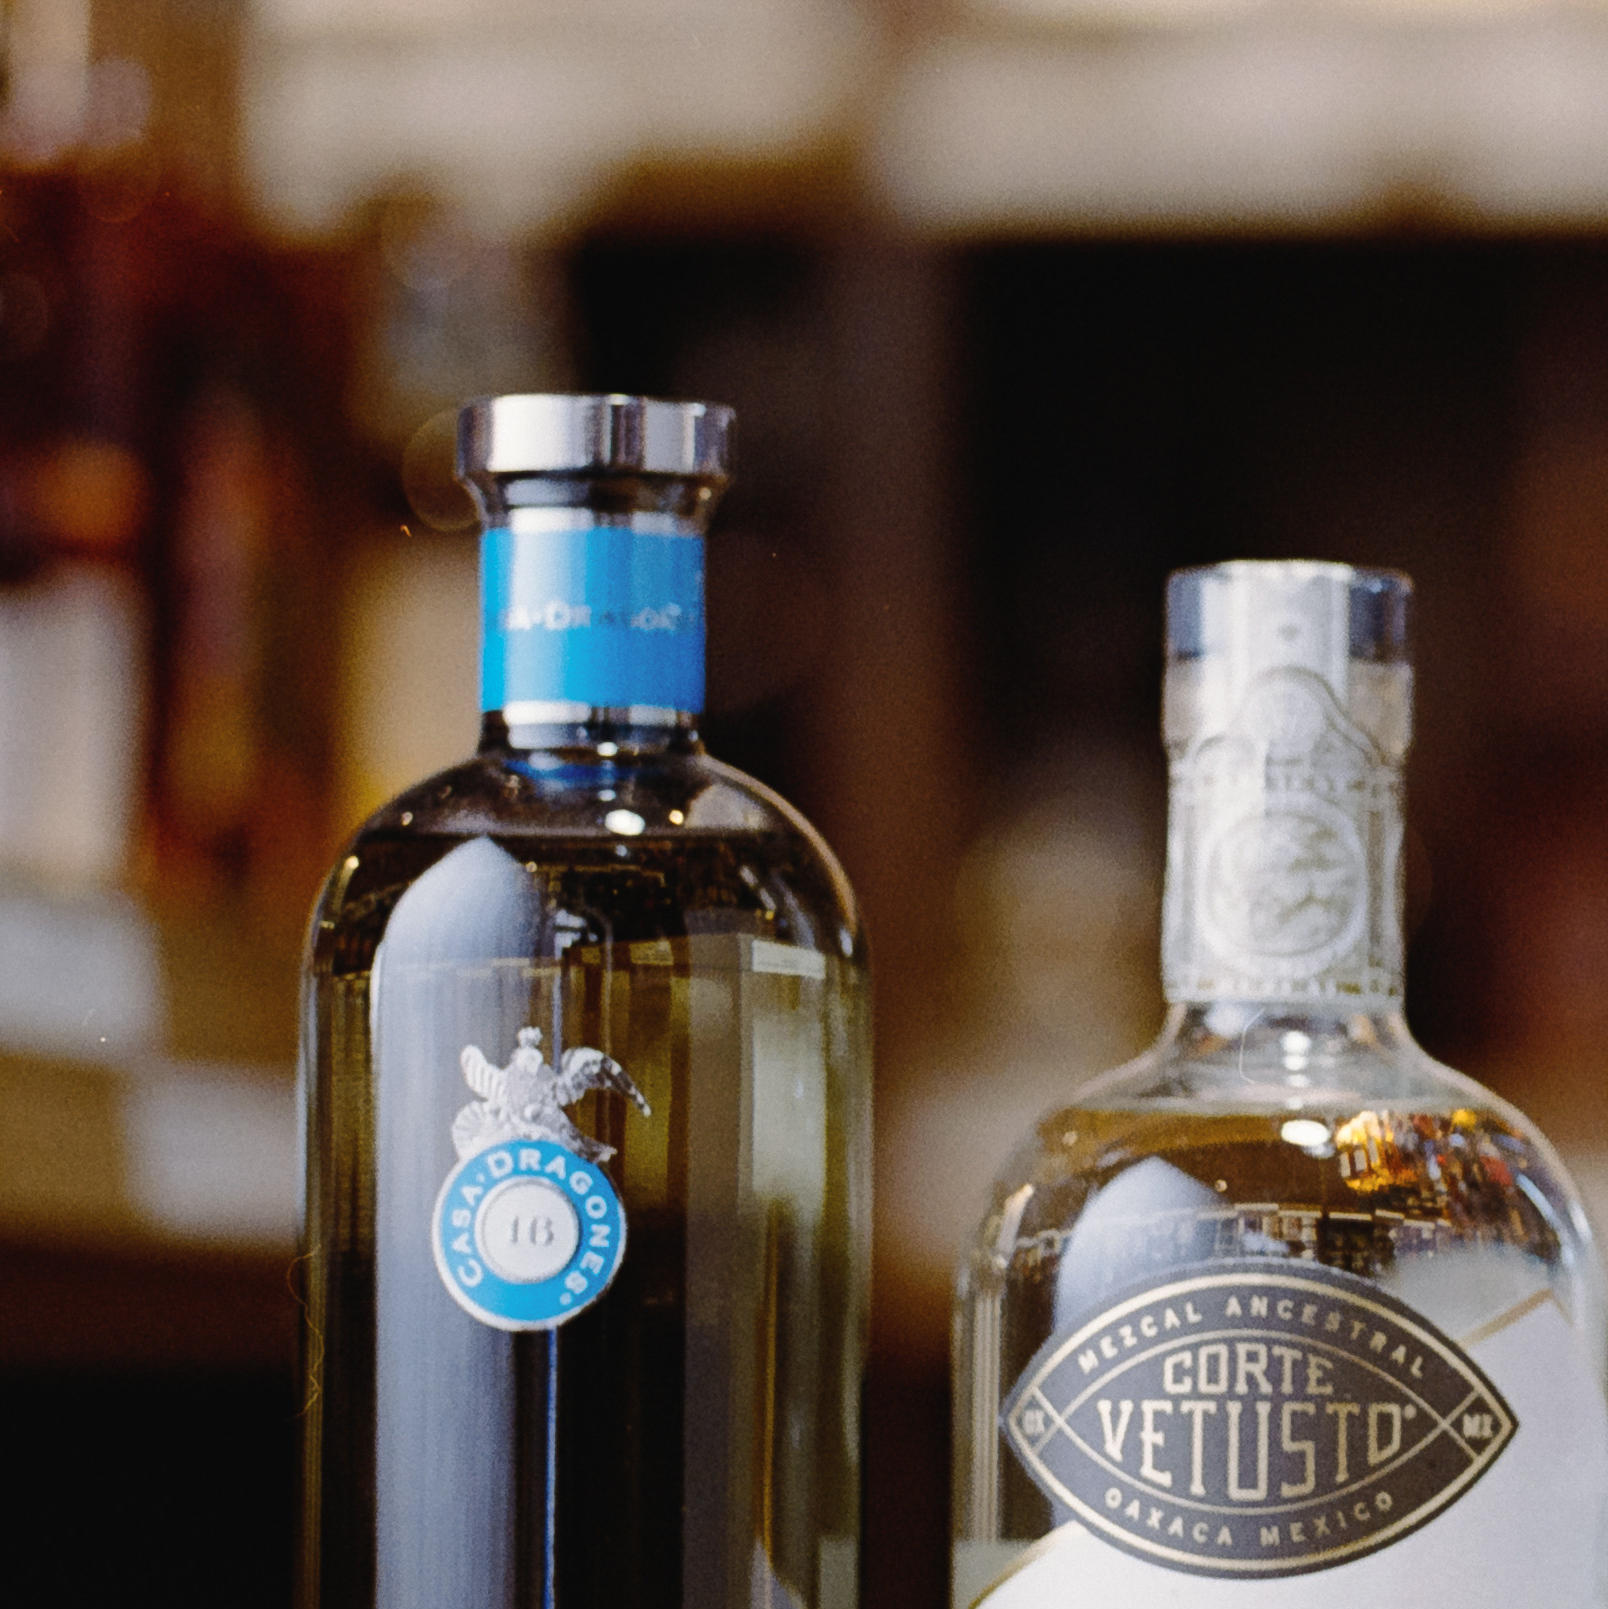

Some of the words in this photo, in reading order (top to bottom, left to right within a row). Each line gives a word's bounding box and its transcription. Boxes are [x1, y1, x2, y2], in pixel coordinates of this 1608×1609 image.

[452, 1185, 484, 1288] CASA
[487, 1148, 611, 1294] DRAGONES
[1078, 1301, 1202, 1375] MEZCAL
[1225, 1294, 1423, 1380] ANCESTRAL
[1163, 1342, 1335, 1396] CORTE
[1096, 1399, 1402, 1502] VETUSTO
[1104, 1487, 1233, 1546] OAXACA
[1259, 1490, 1393, 1546] MEXICO
